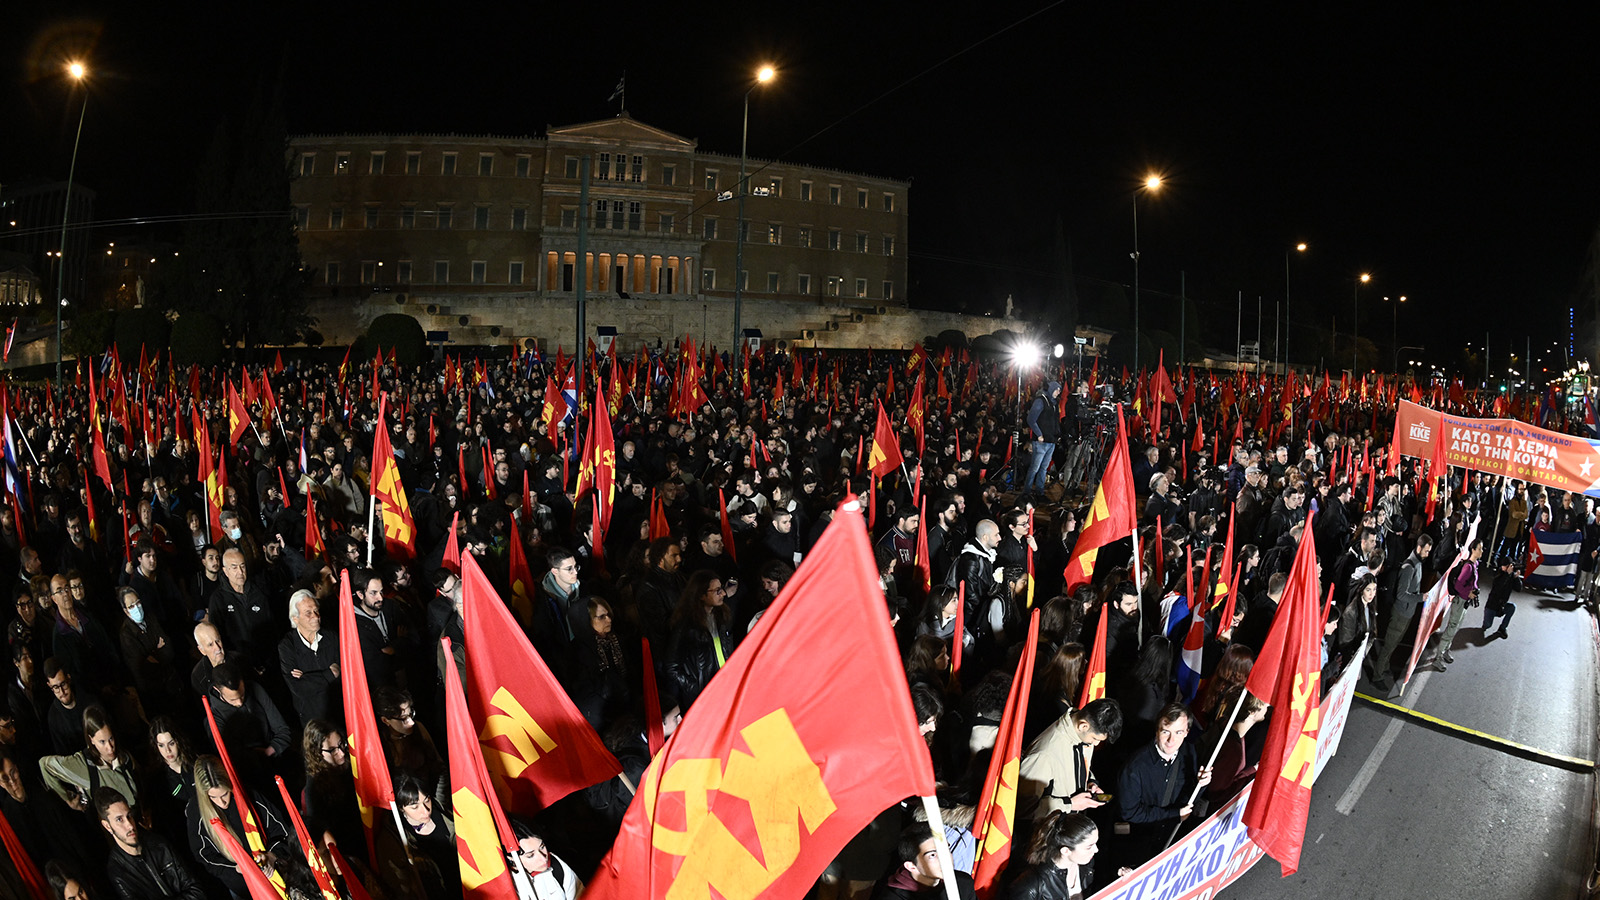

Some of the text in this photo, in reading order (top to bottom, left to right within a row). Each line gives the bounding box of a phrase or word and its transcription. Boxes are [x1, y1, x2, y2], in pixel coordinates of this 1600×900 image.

[1409, 426, 1431, 440] ΚΚΕ
[1451, 427, 1558, 459] ΚΑΤΩ ΤΑ ΧΕΡΙΑ
[1446, 451, 1503, 470] ΙΩΜΑΤΙΚΟΙ
[1517, 467, 1569, 485] ΦΑΝΤΑΡΟΙ
[1451, 440, 1556, 471] ΑΠΟ ΤΗΝ ΚΟΥΒΑ
